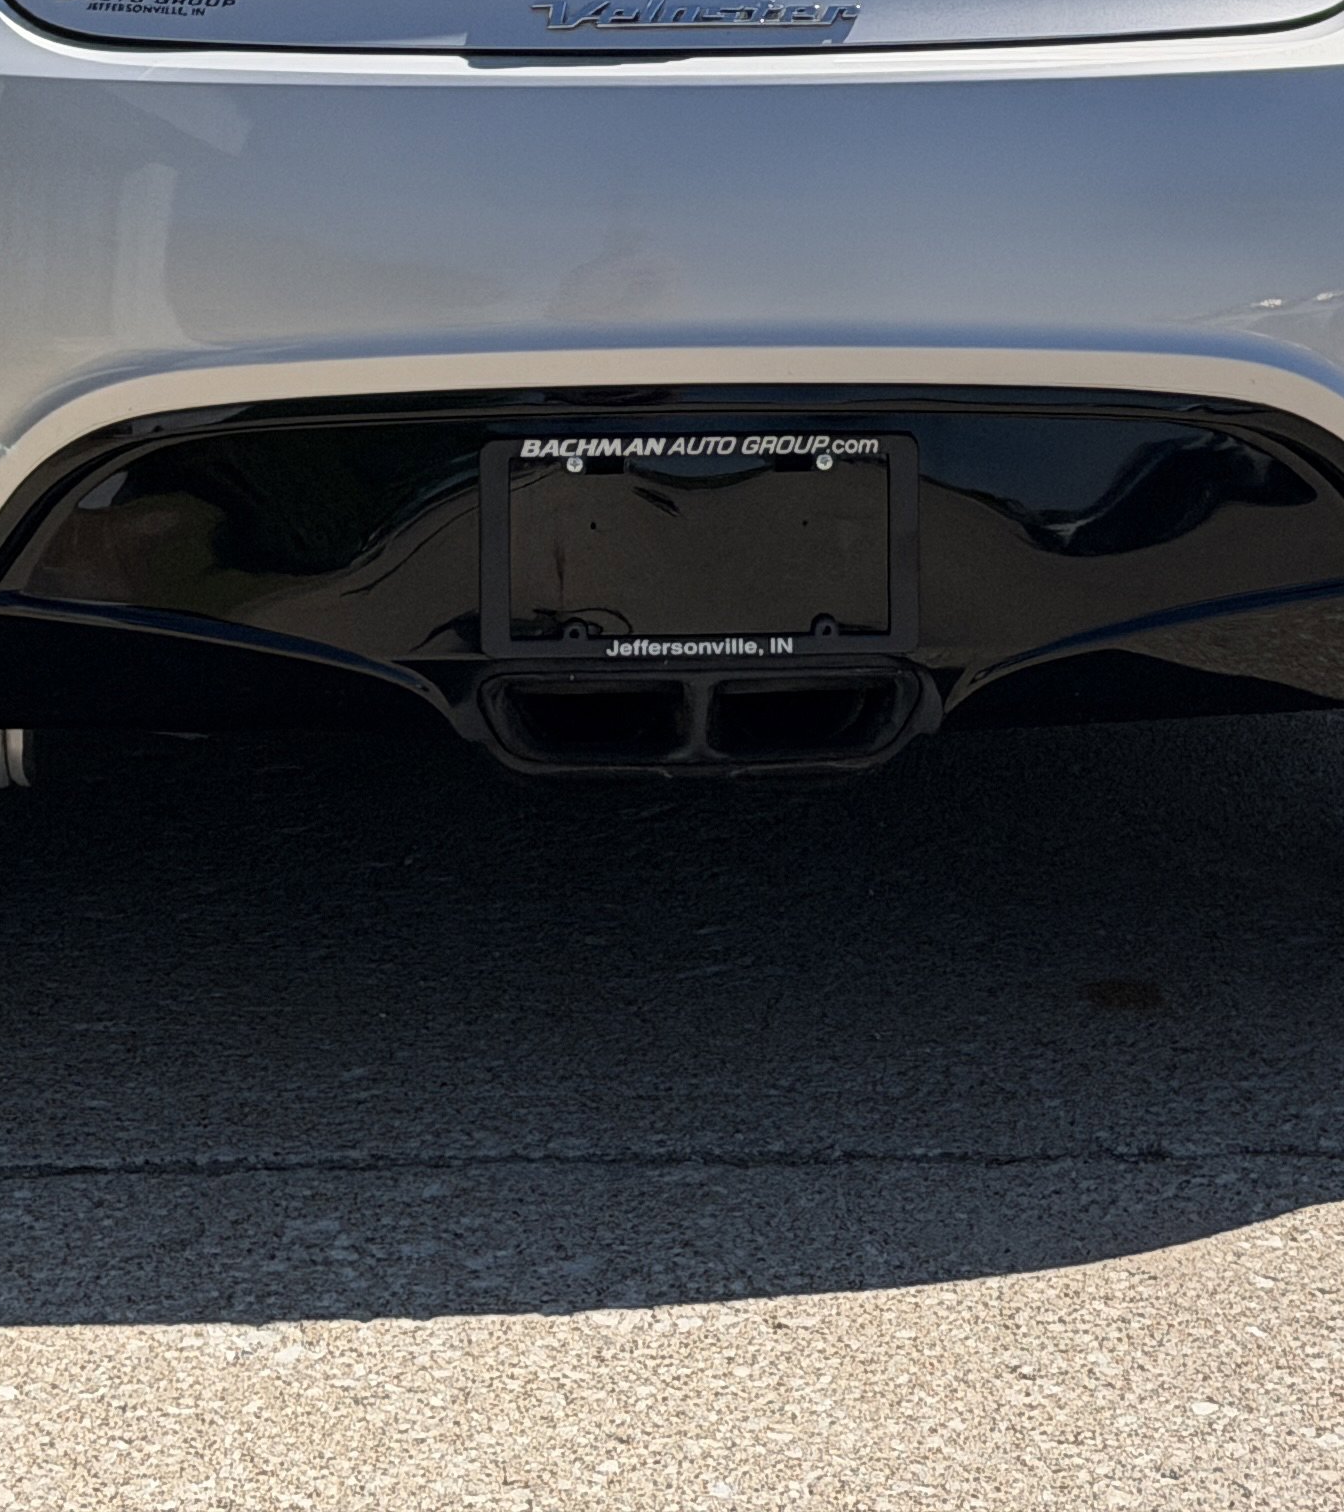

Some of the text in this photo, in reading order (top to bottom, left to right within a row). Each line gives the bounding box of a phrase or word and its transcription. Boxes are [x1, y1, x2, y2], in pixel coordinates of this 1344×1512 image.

[191, 7, 206, 16] IN
[520, 436, 879, 458] BACHMAN AUTO GROUP.com
[606, 637, 793, 657] Jeffersonville, IN
